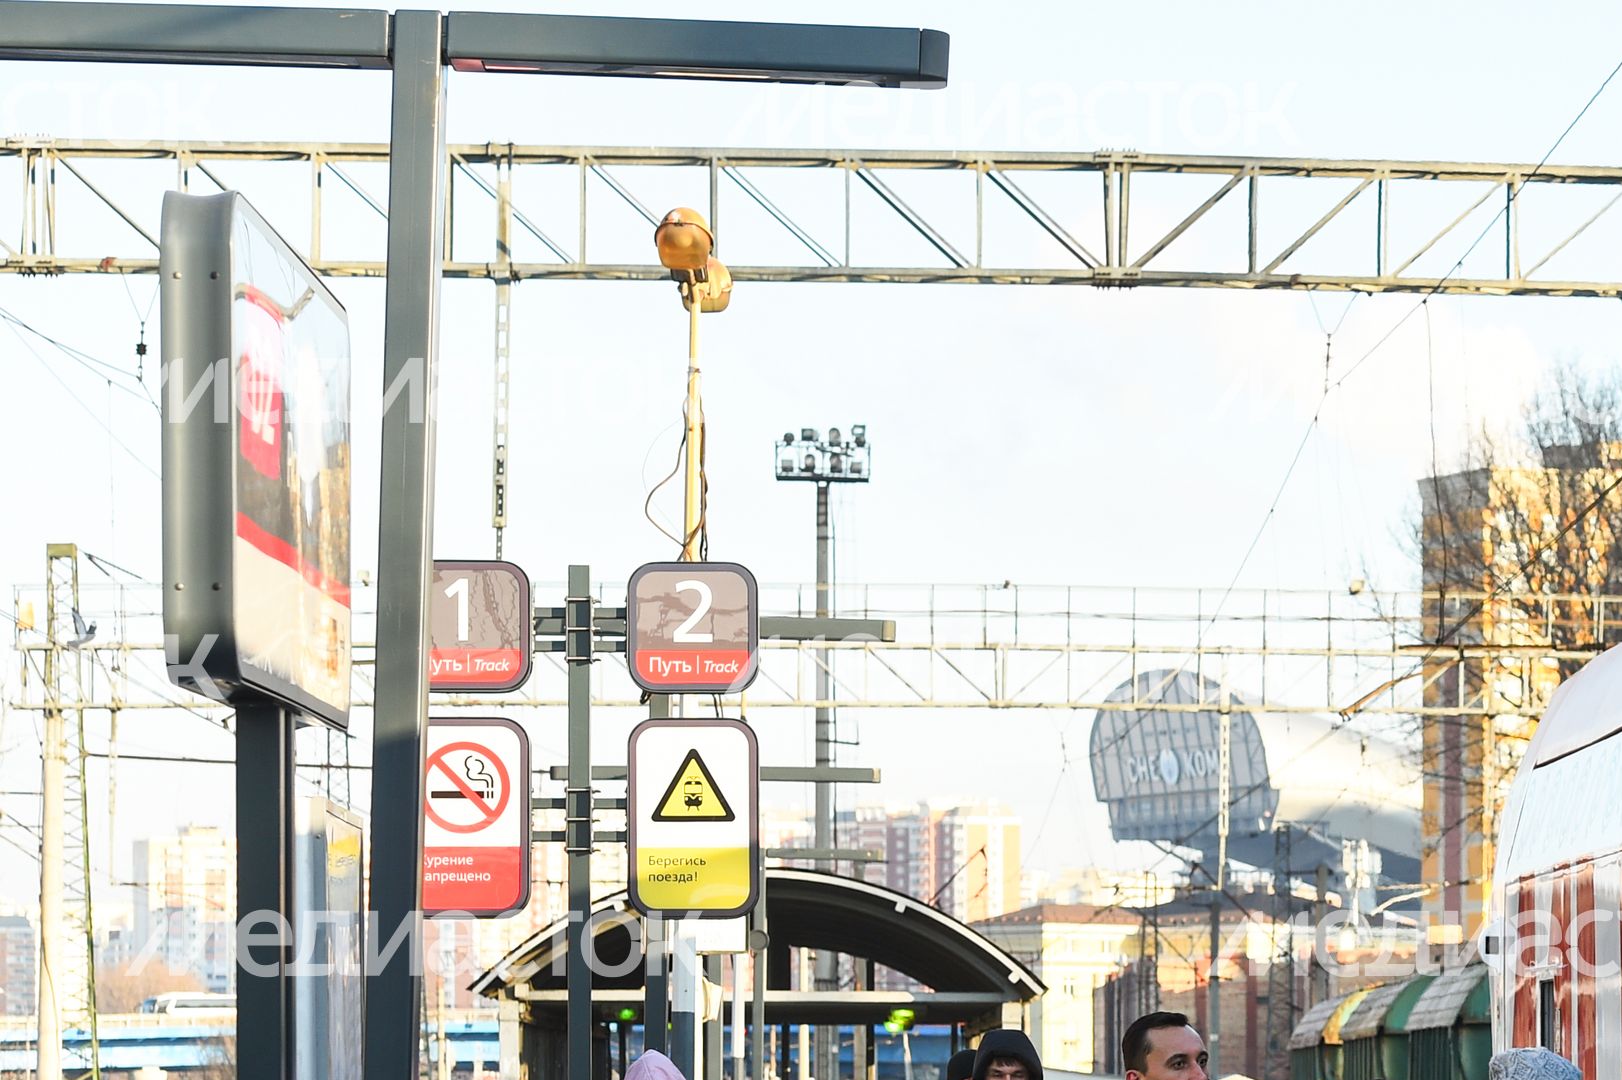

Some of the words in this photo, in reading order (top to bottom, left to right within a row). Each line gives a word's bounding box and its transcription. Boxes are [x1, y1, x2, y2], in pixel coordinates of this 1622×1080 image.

[443, 577, 470, 642] 1
[672, 579, 714, 643] 2
[428, 655, 463, 676] уть
[474, 658, 510, 672] Track
[649, 656, 692, 677] Путь
[703, 659, 739, 674] Track
[648, 854, 706, 870] Берегись
[648, 870, 698, 884] поезда!
